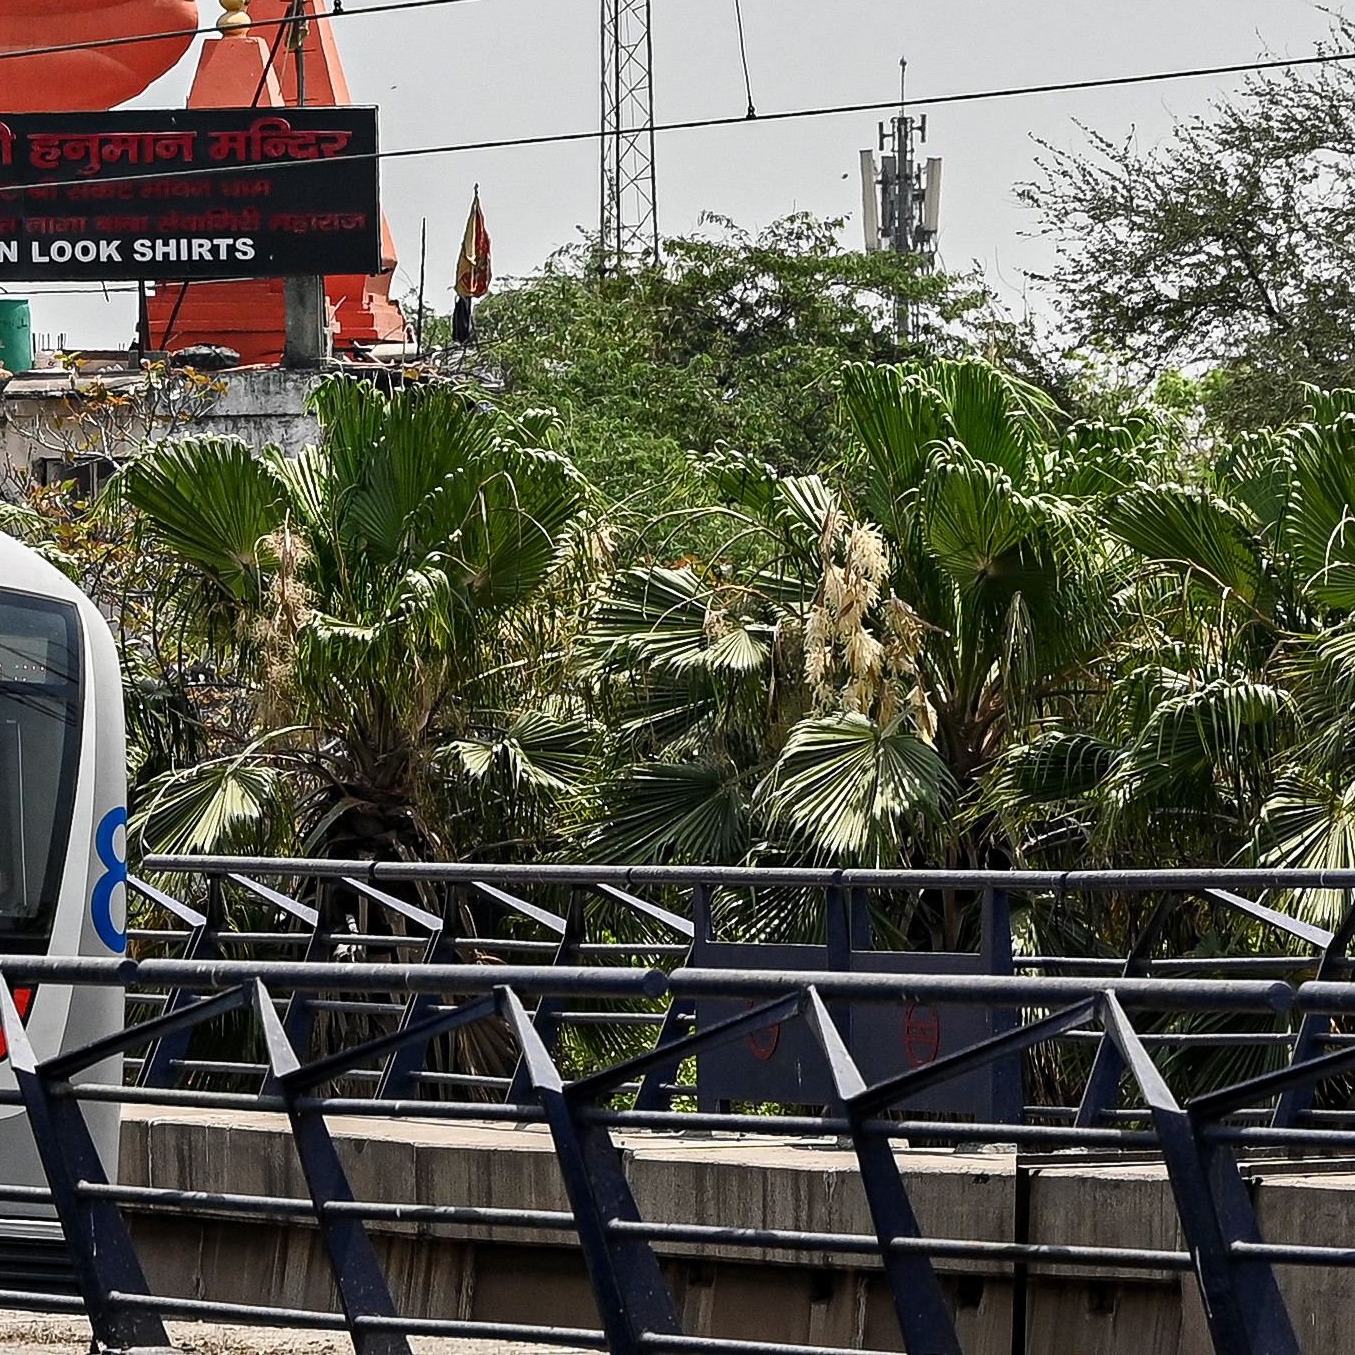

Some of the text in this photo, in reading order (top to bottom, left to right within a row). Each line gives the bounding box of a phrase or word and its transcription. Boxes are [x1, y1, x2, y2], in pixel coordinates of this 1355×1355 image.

[27, 131, 197, 175] हनुमान
[208, 117, 352, 162] मन्दिर
[31, 239, 123, 263] LOOK
[133, 237, 256, 261] SHIRTS
[91, 806, 127, 954] 8
